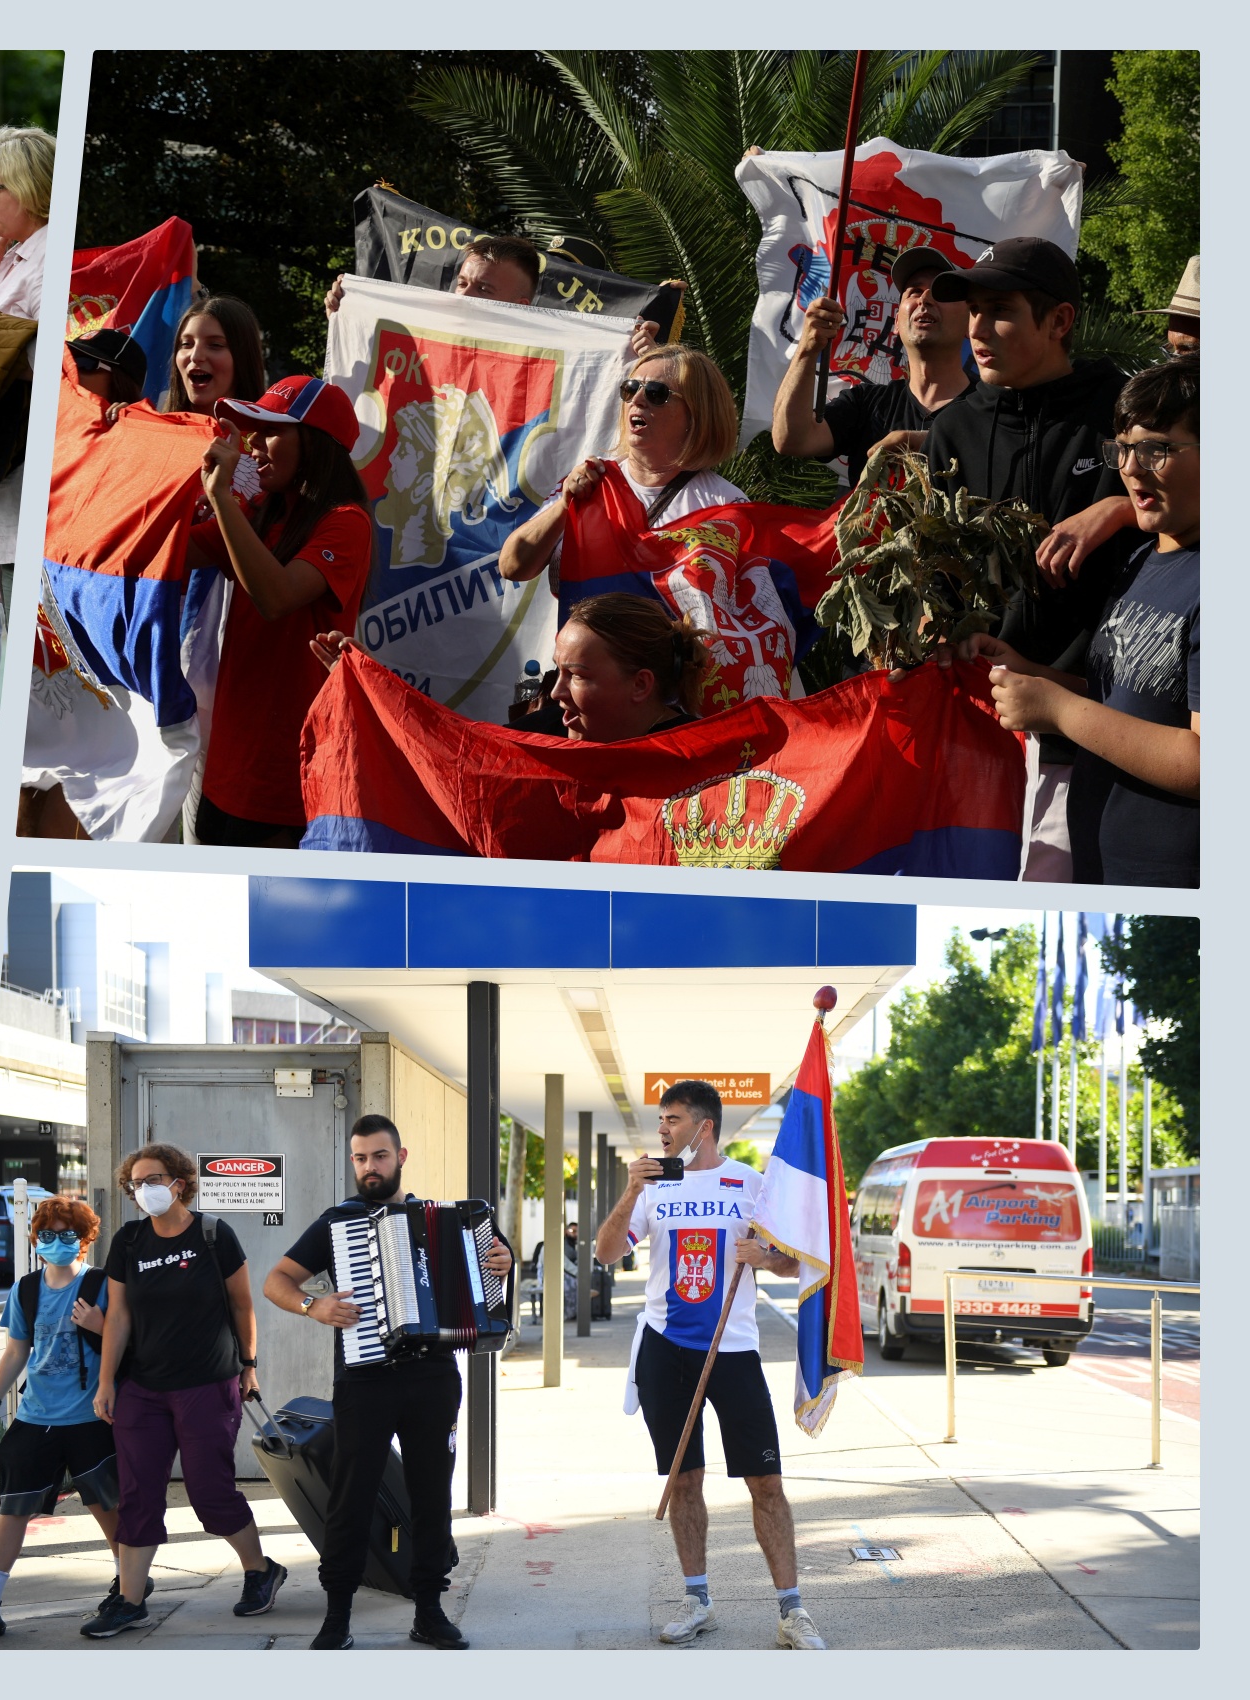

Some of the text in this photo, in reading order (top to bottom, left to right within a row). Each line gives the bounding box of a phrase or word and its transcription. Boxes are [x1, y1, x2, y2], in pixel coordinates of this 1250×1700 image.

[383, 347, 429, 386] ФК
[1076, 457, 1096, 469] NIKE
[728, 1078, 737, 1088] &
[739, 1077, 754, 1087] off
[735, 1089, 763, 1098] buses
[216, 1162, 265, 1172] DANGER
[656, 1201, 743, 1220] SERBIA
[921, 1189, 1040, 1232] A1 Airport
[985, 1212, 1062, 1228] Parking
[918, 1240, 1077, 1251] www.a1airportparking.com.au
[138, 1249, 197, 1272] just do it.
[953, 1302, 1042, 1315] 9330 4442
